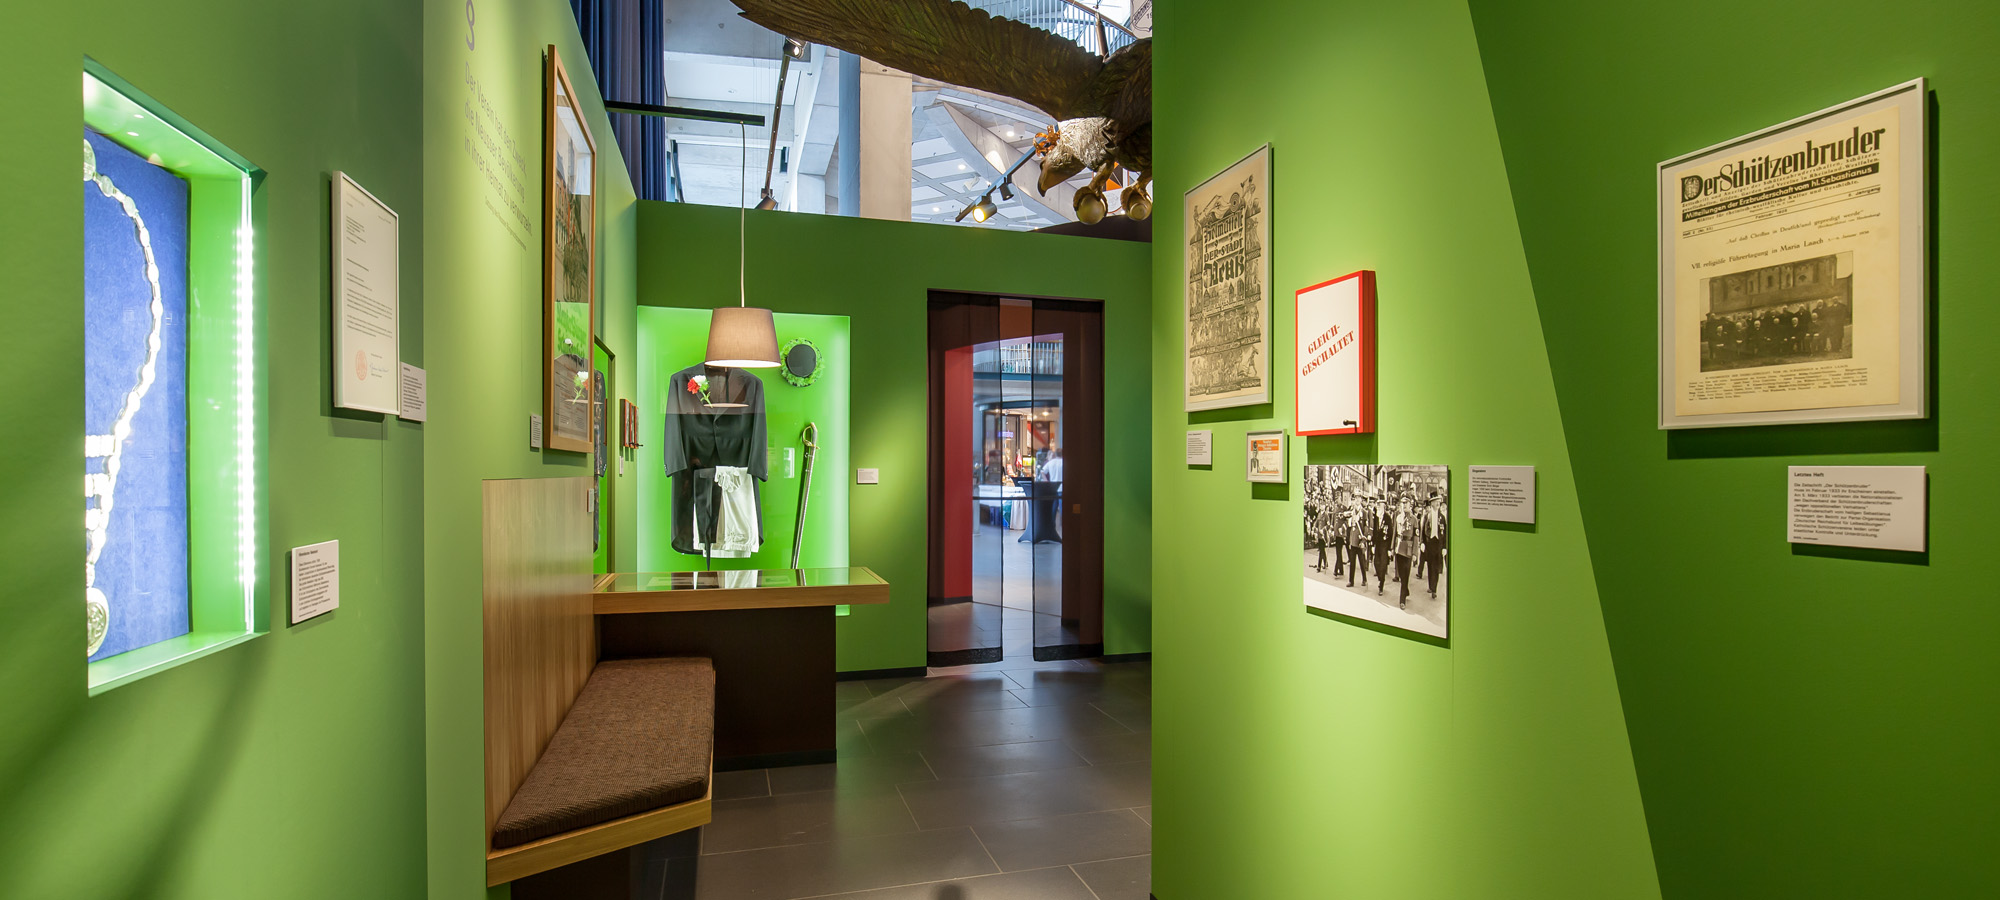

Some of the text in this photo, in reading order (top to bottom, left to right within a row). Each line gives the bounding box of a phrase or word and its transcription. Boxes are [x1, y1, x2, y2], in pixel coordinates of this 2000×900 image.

[466, 61, 476, 94] Der
[1681, 126, 1886, 203] Der Schützenbruder
[1685, 205, 1727, 220] Mitteilungen
[1727, 200, 1738, 209] der
[1740, 186, 1793, 205] Erzbruderschaft
[1794, 182, 1809, 191] vom
[1820, 166, 1872, 184] Sebastianus
[1780, 244, 1800, 252] Maria
[1804, 238, 1823, 247] Laach
[1302, 330, 1354, 376] GESCHALTET
[1308, 324, 1340, 354] GLEICH-
